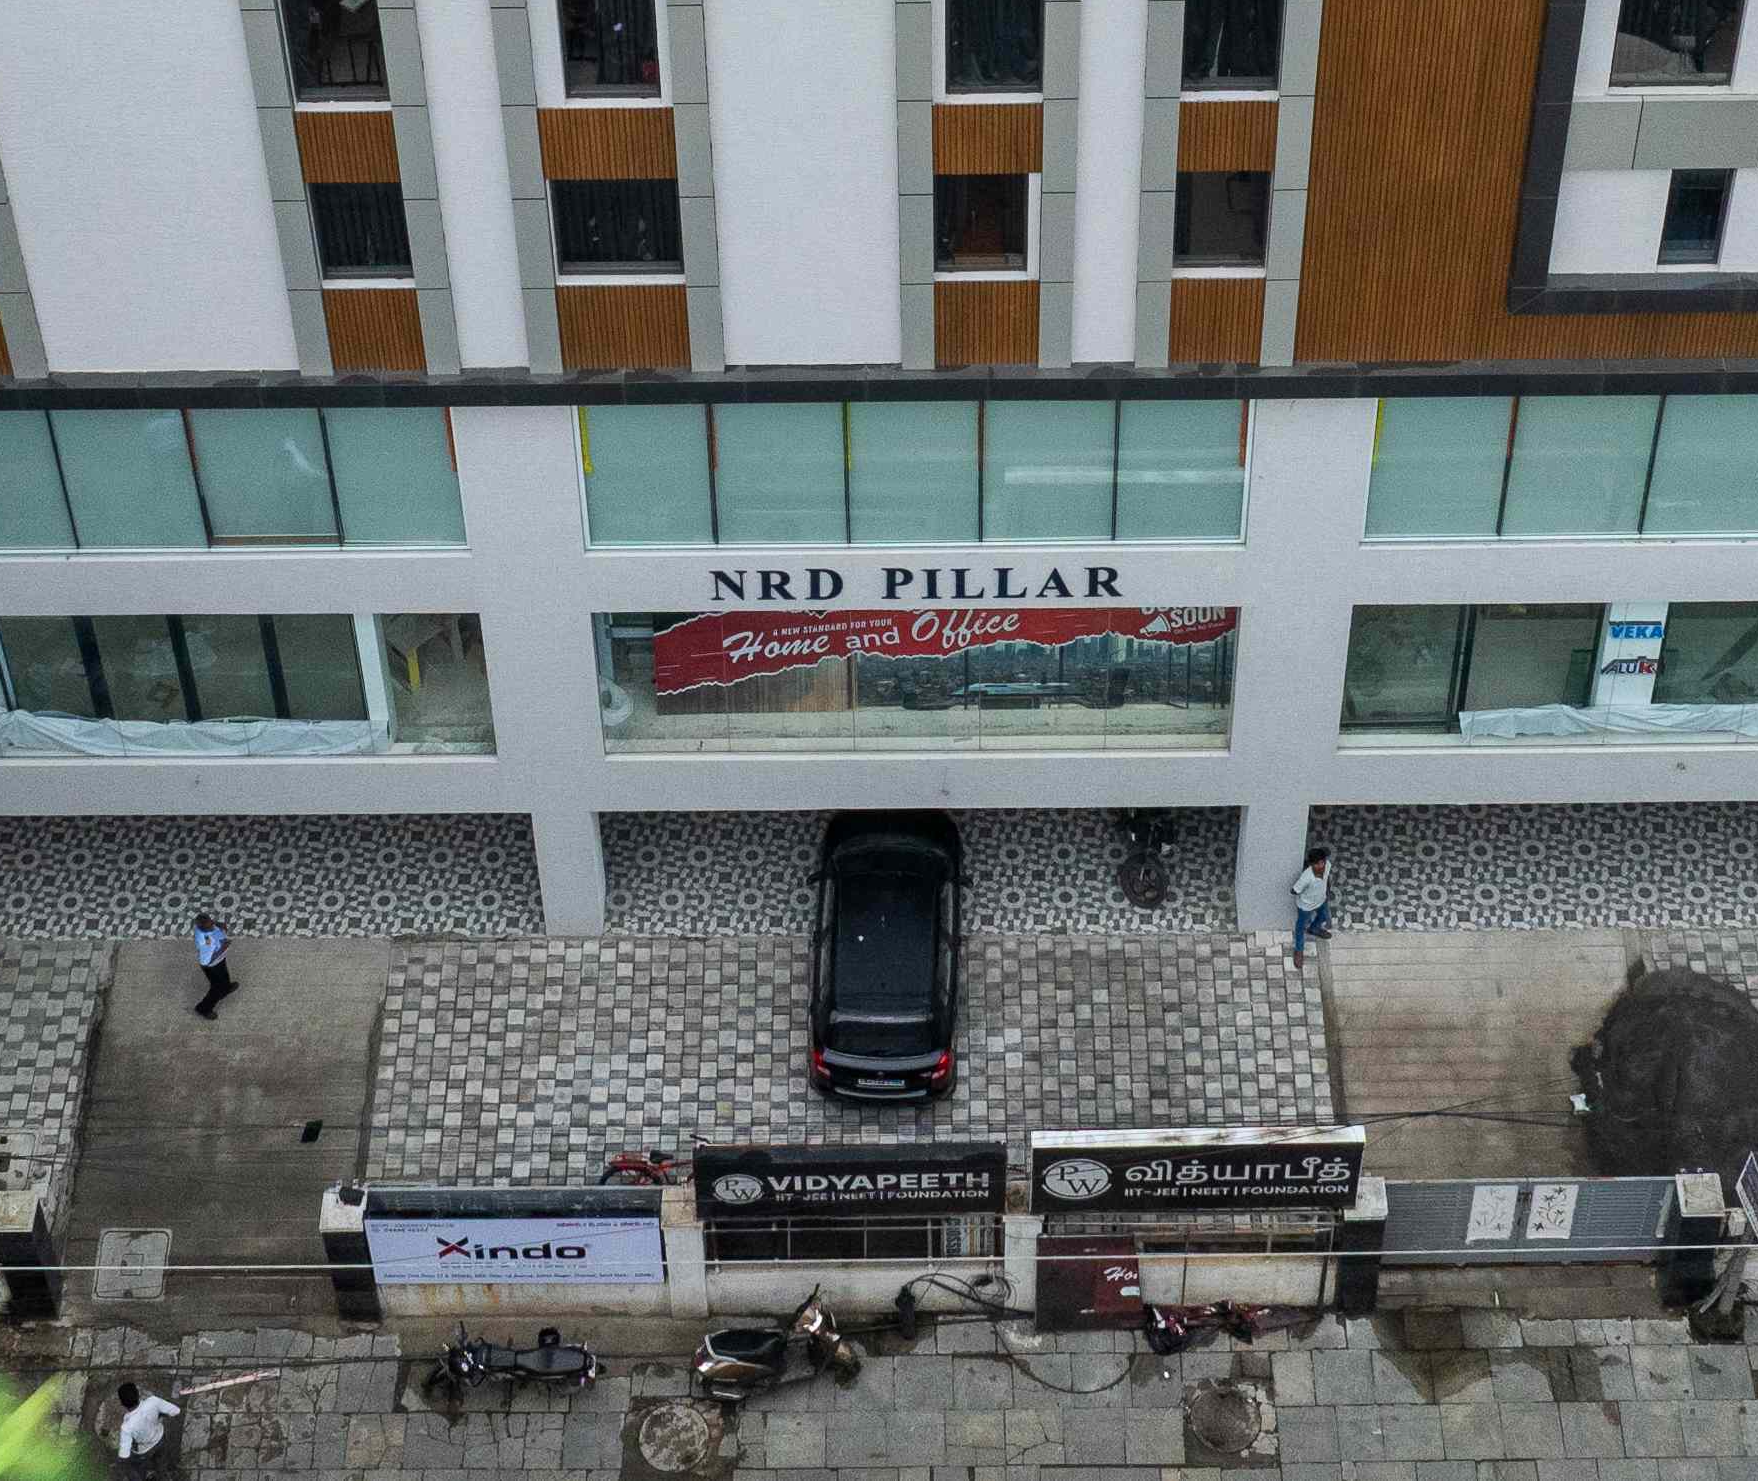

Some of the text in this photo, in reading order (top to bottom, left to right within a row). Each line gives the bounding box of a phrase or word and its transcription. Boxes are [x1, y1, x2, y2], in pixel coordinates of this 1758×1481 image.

[708, 565, 1124, 601] NRD PILLAR
[781, 626, 801, 636] NEW
[803, 622, 848, 635] STANDARD
[850, 620, 867, 629] FOR
[869, 618, 893, 628] YOUR
[1169, 606, 1227, 628] SOON
[722, 608, 1021, 663] Home and Office
[1610, 623, 1663, 639] VEKA
[1124, 1156, 1352, 1186] வித்யாபீத்
[767, 1172, 991, 1192] VIDYAPEETH
[1191, 1186, 1229, 1196] NEET
[1242, 1184, 1350, 1196] FOUNDATION
[887, 1189, 990, 1200] FOUNDATION
[436, 1236, 586, 1260] Xindo
